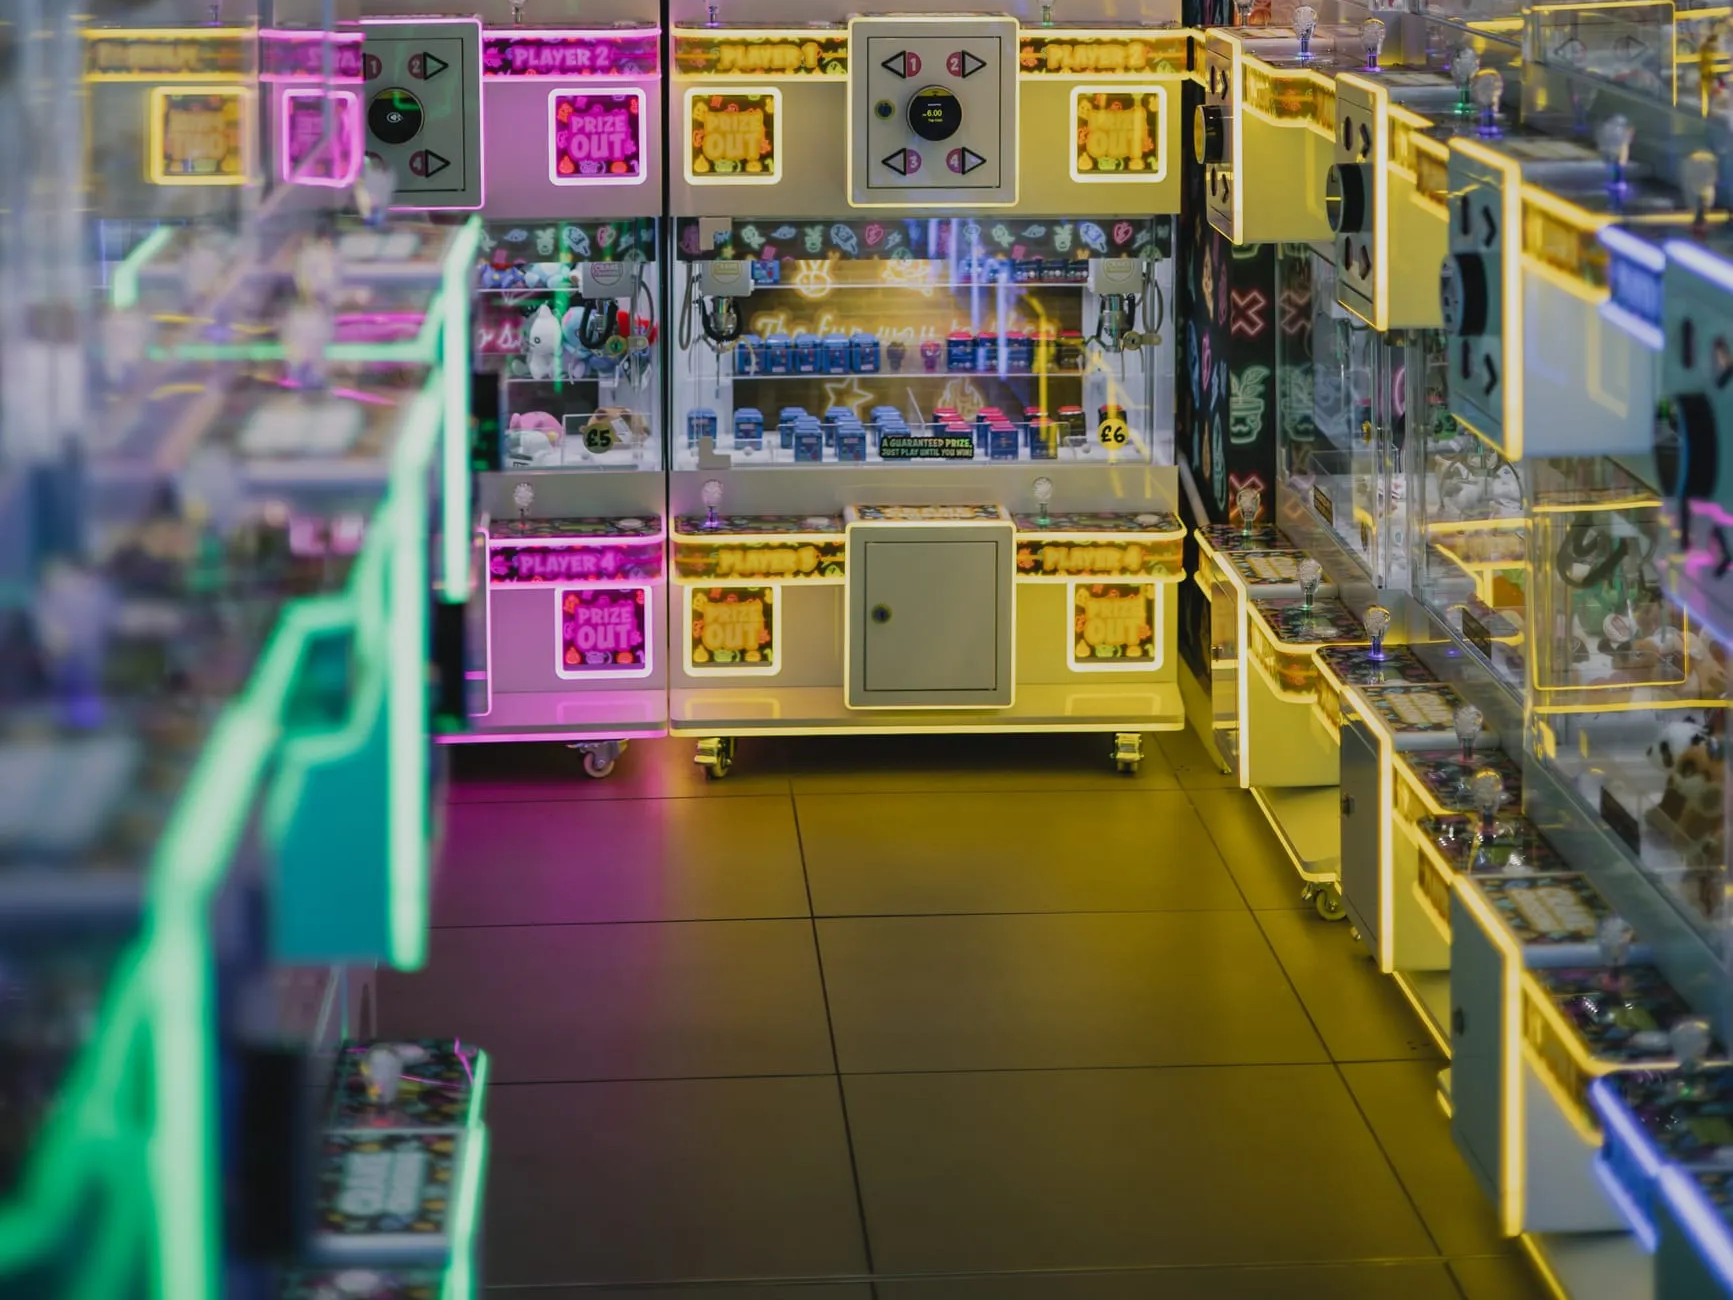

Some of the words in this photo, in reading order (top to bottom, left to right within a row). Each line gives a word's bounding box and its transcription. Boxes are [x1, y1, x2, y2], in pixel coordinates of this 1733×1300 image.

[513, 47, 592, 67] PLAYER
[595, 46, 609, 66] 2
[719, 45, 800, 68] PLAYER
[910, 58, 916, 71] 1
[951, 58, 959, 71] 2
[1048, 45, 1125, 68] PLAYER
[370, 61, 377, 73] 1
[412, 60, 420, 73] 2
[571, 115, 627, 133] PRIZE
[707, 114, 762, 132] PRIZE
[570, 133, 626, 159] OUT
[706, 132, 760, 159] OUT
[910, 155, 918, 168] 3
[950, 154, 959, 167] 4
[586, 432, 612, 448] £5
[882, 439, 888, 447] A
[889, 439, 944, 447] GUARANTEED
[1101, 425, 1126, 443] £6
[882, 448, 899, 456] JUST
[901, 448, 919, 456] PLAY
[920, 448, 939, 456] UNTIL
[942, 448, 955, 456] YOU
[519, 555, 597, 574] PLAYER
[601, 551, 616, 572] 4
[719, 549, 797, 572] PLAYER
[1044, 547, 1121, 570] PLAYER
[577, 607, 632, 624] PRIZE
[706, 606, 760, 623] PRIZE
[576, 624, 631, 650] OUT
[705, 622, 759, 649] OUT
[1086, 618, 1141, 645] OUT
